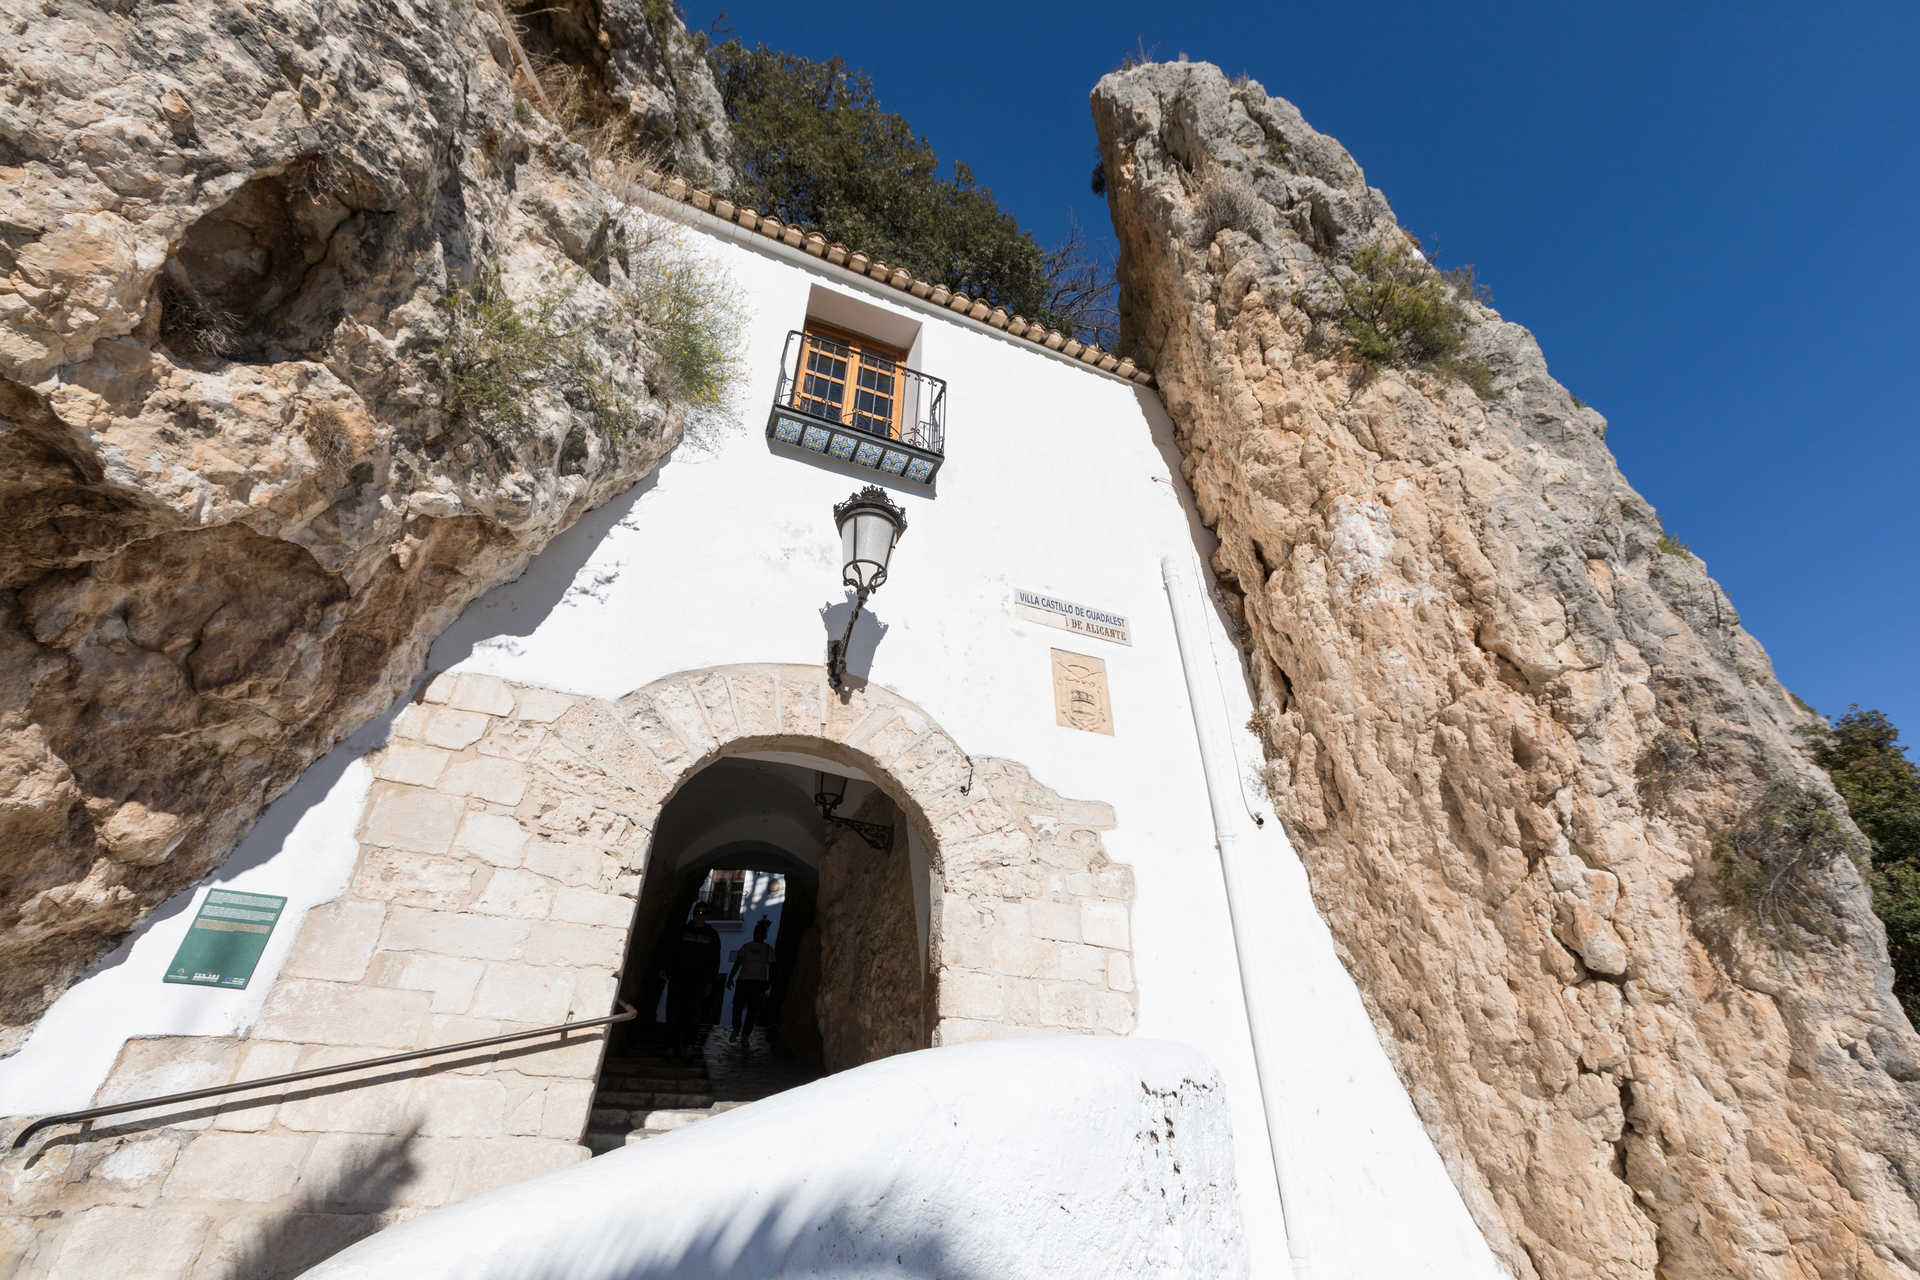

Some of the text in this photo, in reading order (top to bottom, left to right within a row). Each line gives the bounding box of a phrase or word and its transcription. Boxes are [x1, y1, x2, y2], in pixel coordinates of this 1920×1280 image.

[1019, 591, 1125, 628] VILLA CASTILLO DE GUADALEST
[1071, 618, 1127, 641] DE ALICANTE
